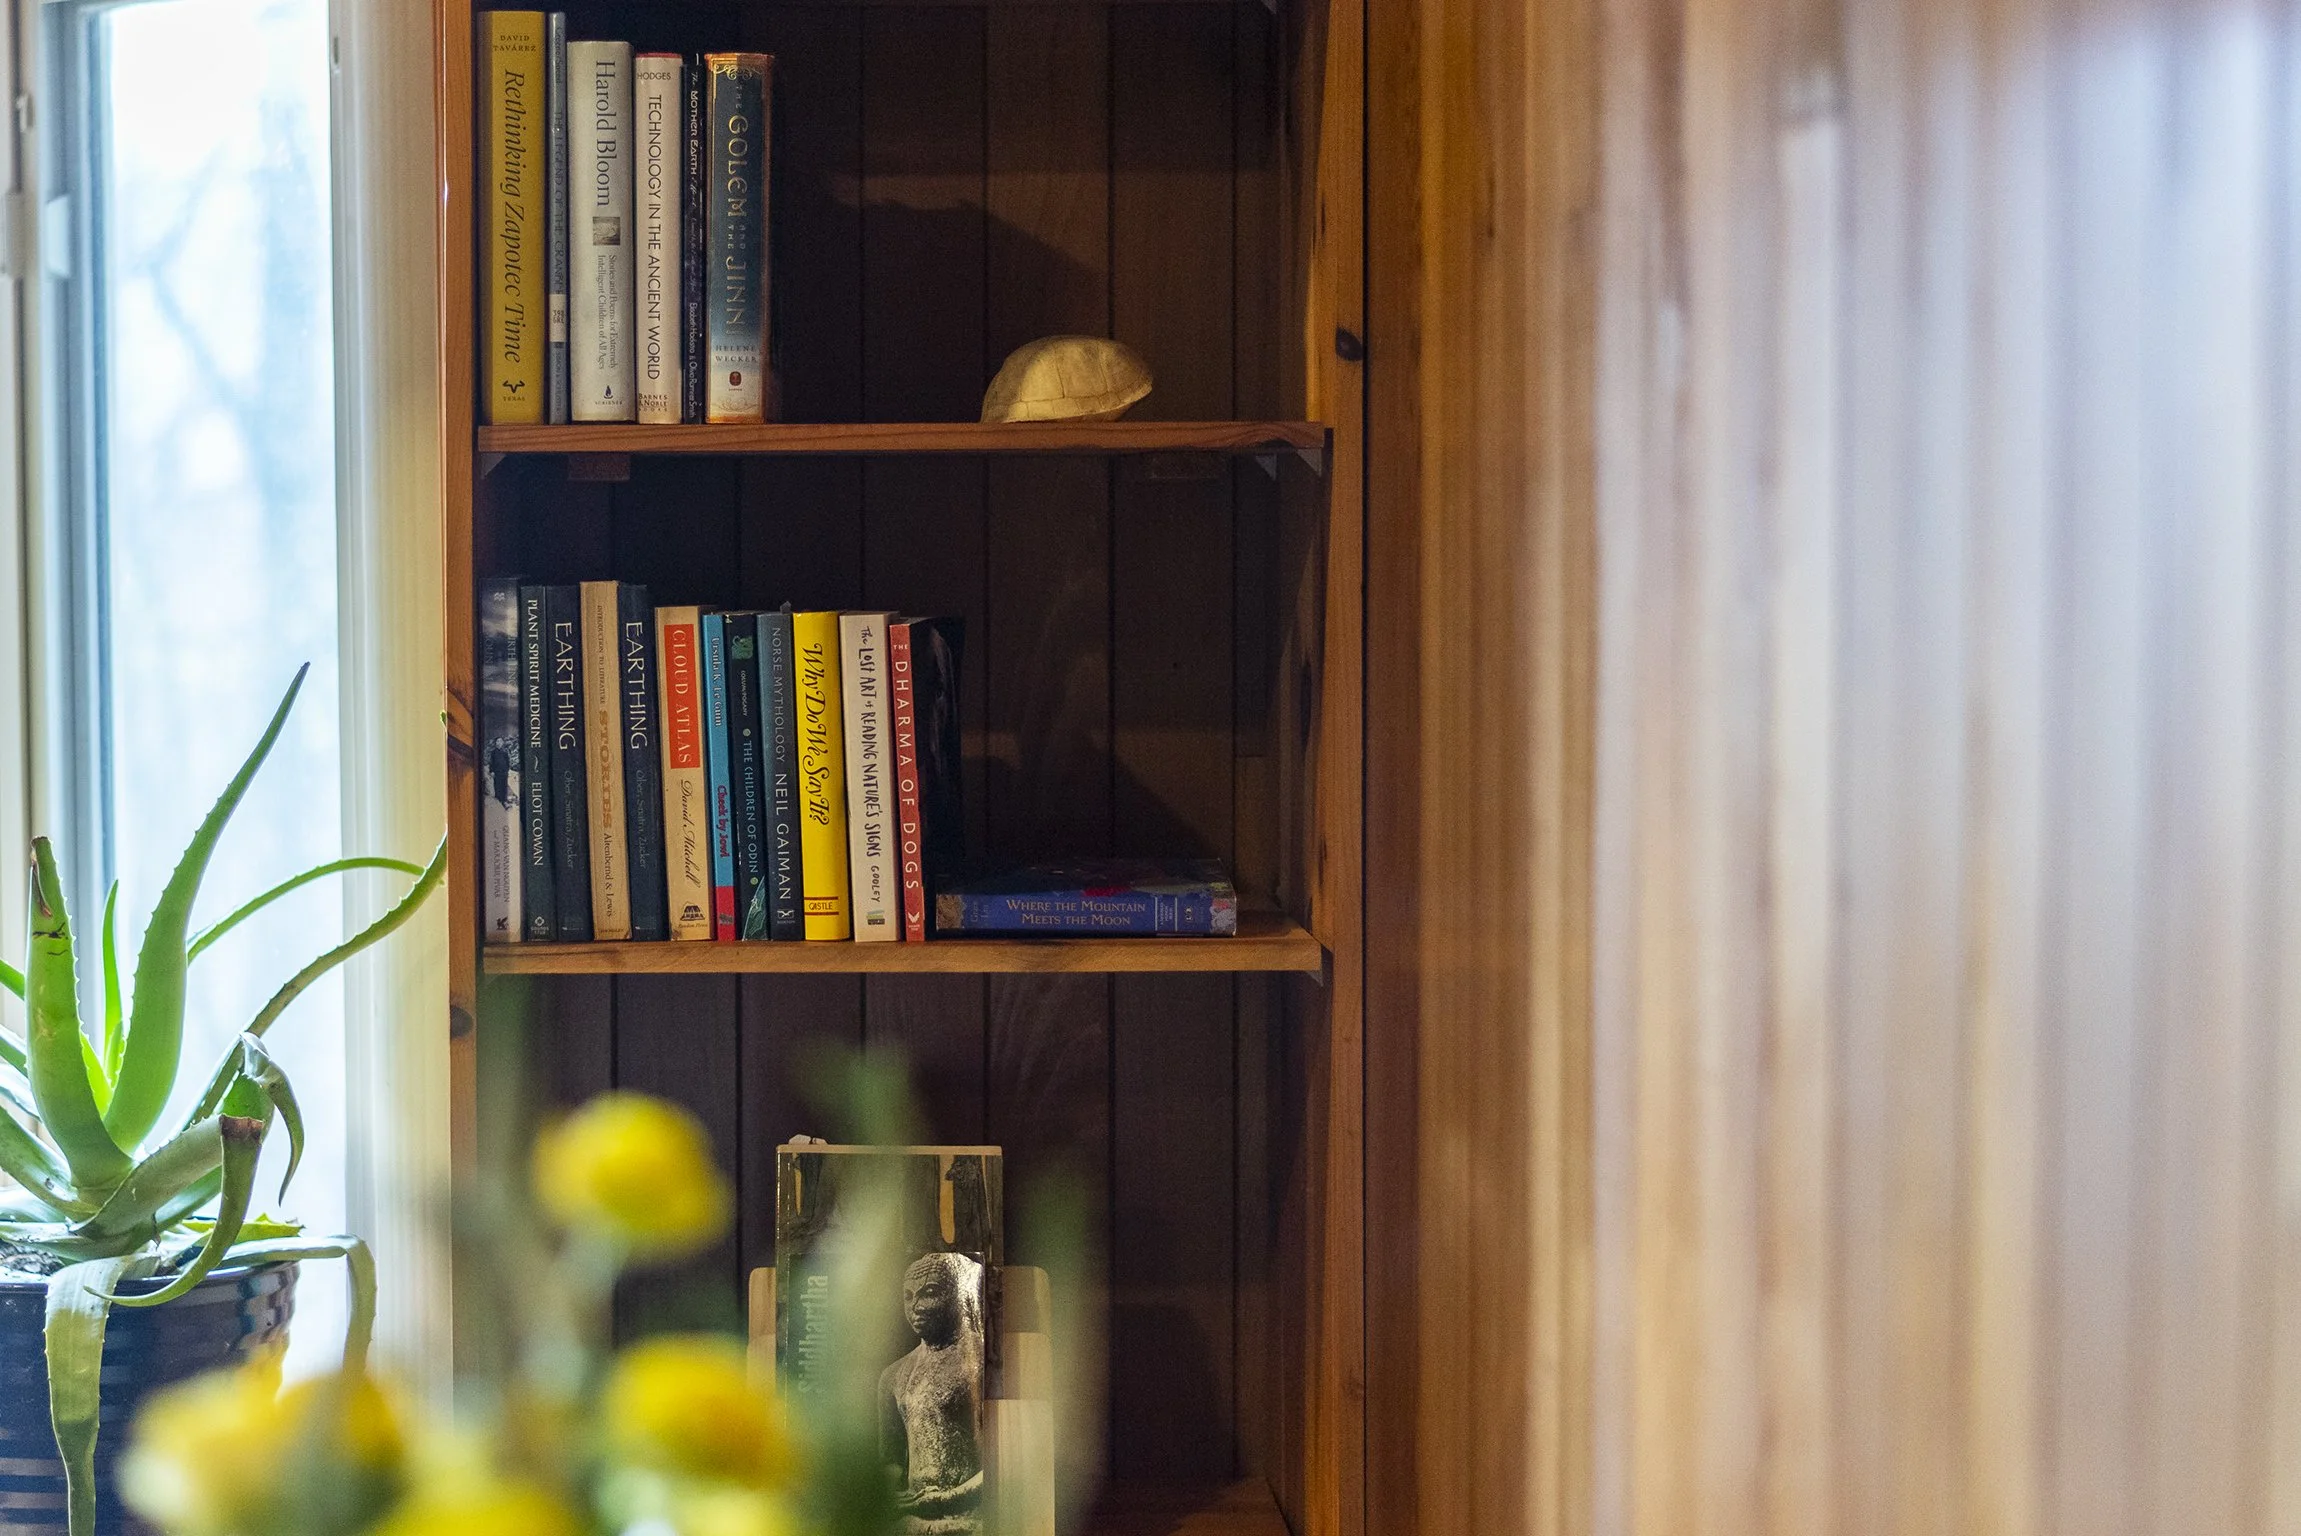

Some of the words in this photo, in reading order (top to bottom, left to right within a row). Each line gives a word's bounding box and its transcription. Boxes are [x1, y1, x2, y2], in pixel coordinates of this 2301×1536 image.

[493, 44, 537, 52] TAVÁREZ
[500, 34, 530, 42] DAVID
[637, 72, 671, 80] HODGES
[596, 61, 617, 131] Harold
[690, 91, 699, 136] MOTHER
[500, 69, 527, 198] Rethinking
[648, 95, 662, 199] TECHNOLOGY
[596, 139, 618, 207] Bloom
[690, 139, 699, 175] EARTH
[728, 115, 749, 217] GOLEM
[648, 203, 661, 220] IN
[500, 201, 525, 297] Zapotec
[648, 224, 661, 250] THE
[597, 255, 607, 294] Intelligent
[609, 255, 617, 280] Stories
[609, 281, 617, 295] and
[648, 255, 661, 322] ANCIENT
[598, 295, 607, 329] Children
[609, 296, 618, 320] Poems
[504, 303, 526, 363] Time
[598, 330, 607, 339] of
[610, 321, 618, 332] for
[597, 352, 607, 370] Ages
[598, 340, 607, 351] All
[647, 326, 661, 380] WORLD
[528, 599, 539, 640] PLANT
[861, 626, 873, 645] The
[529, 643, 539, 682] SPIRIT
[672, 629, 690, 694] CLOUD
[712, 637, 722, 670] Ursula
[772, 627, 782, 671] NORSE
[802, 643, 825, 690] Why
[555, 622, 577, 750] EARTHING
[626, 621, 648, 749] EARTHING
[713, 673, 721, 684] K.
[714, 687, 722, 699] Le
[860, 677, 877, 699] ART
[530, 685, 542, 748] MEDICINE
[714, 701, 723, 727] Guin
[773, 676, 785, 763] MYTHOLOGY
[804, 690, 826, 723] Do
[895, 661, 913, 767] DHARMA
[675, 703, 692, 763] ATLAS
[806, 723, 828, 756] We
[861, 712, 879, 760] READING
[599, 710, 612, 829] STORIES
[743, 740, 753, 763] THE
[745, 766, 756, 820] CHILDREN
[803, 755, 830, 797] Say
[862, 763, 883, 818] NATURE'S
[900, 779, 915, 806] OF
[532, 782, 542, 816] ELIOT
[681, 779, 695, 826] David
[718, 785, 728, 816] Cheek
[775, 774, 788, 816] NEIL
[809, 797, 830, 825] It?
[533, 818, 543, 866] COWAN
[716, 819, 728, 831] by
[747, 824, 756, 840] OF
[864, 823, 882, 857] SIGNS
[603, 833, 615, 881] Altenbernd
[682, 824, 701, 888] Mitchell
[748, 843, 758, 873] ODIN
[777, 823, 791, 899] GAIMAN
[903, 823, 919, 889] DOGS
[605, 883, 612, 891] &
[871, 866, 881, 903] GOOLEY
[606, 893, 616, 918] Lewis
[808, 902, 833, 910] CASTLE
[1006, 899, 1052, 912] WHERE
[1055, 902, 1078, 911] THE
[1081, 901, 1146, 912] MOUNTAIN
[1021, 914, 1061, 925] MEETS
[1064, 916, 1087, 925] THE
[1091, 914, 1131, 925] MOON
